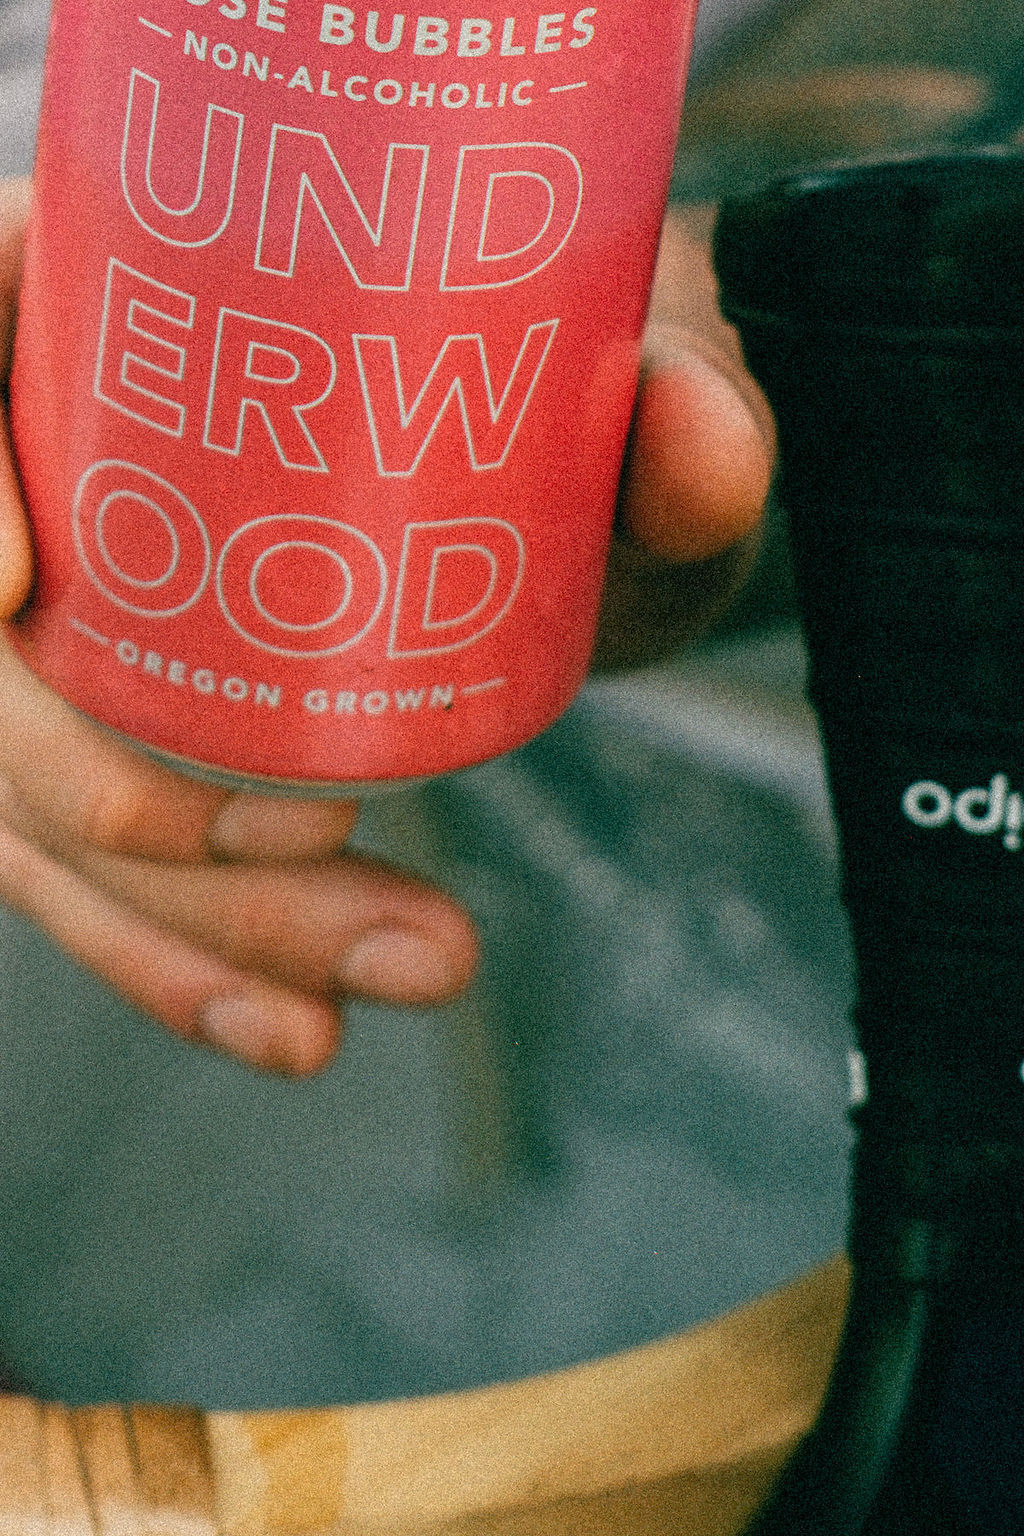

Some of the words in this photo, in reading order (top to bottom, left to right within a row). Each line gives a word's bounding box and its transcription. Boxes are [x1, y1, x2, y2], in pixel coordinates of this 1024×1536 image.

[182, 29, 535, 110] NON-ALCOHOLIC
[317, 2, 598, 58] BUBBLES
[119, 66, 585, 294] UND
[92, 255, 562, 481] ERW
[70, 459, 528, 661] OOD
[114, 639, 283, 710] OREGON
[302, 683, 455, 717] GROWN
